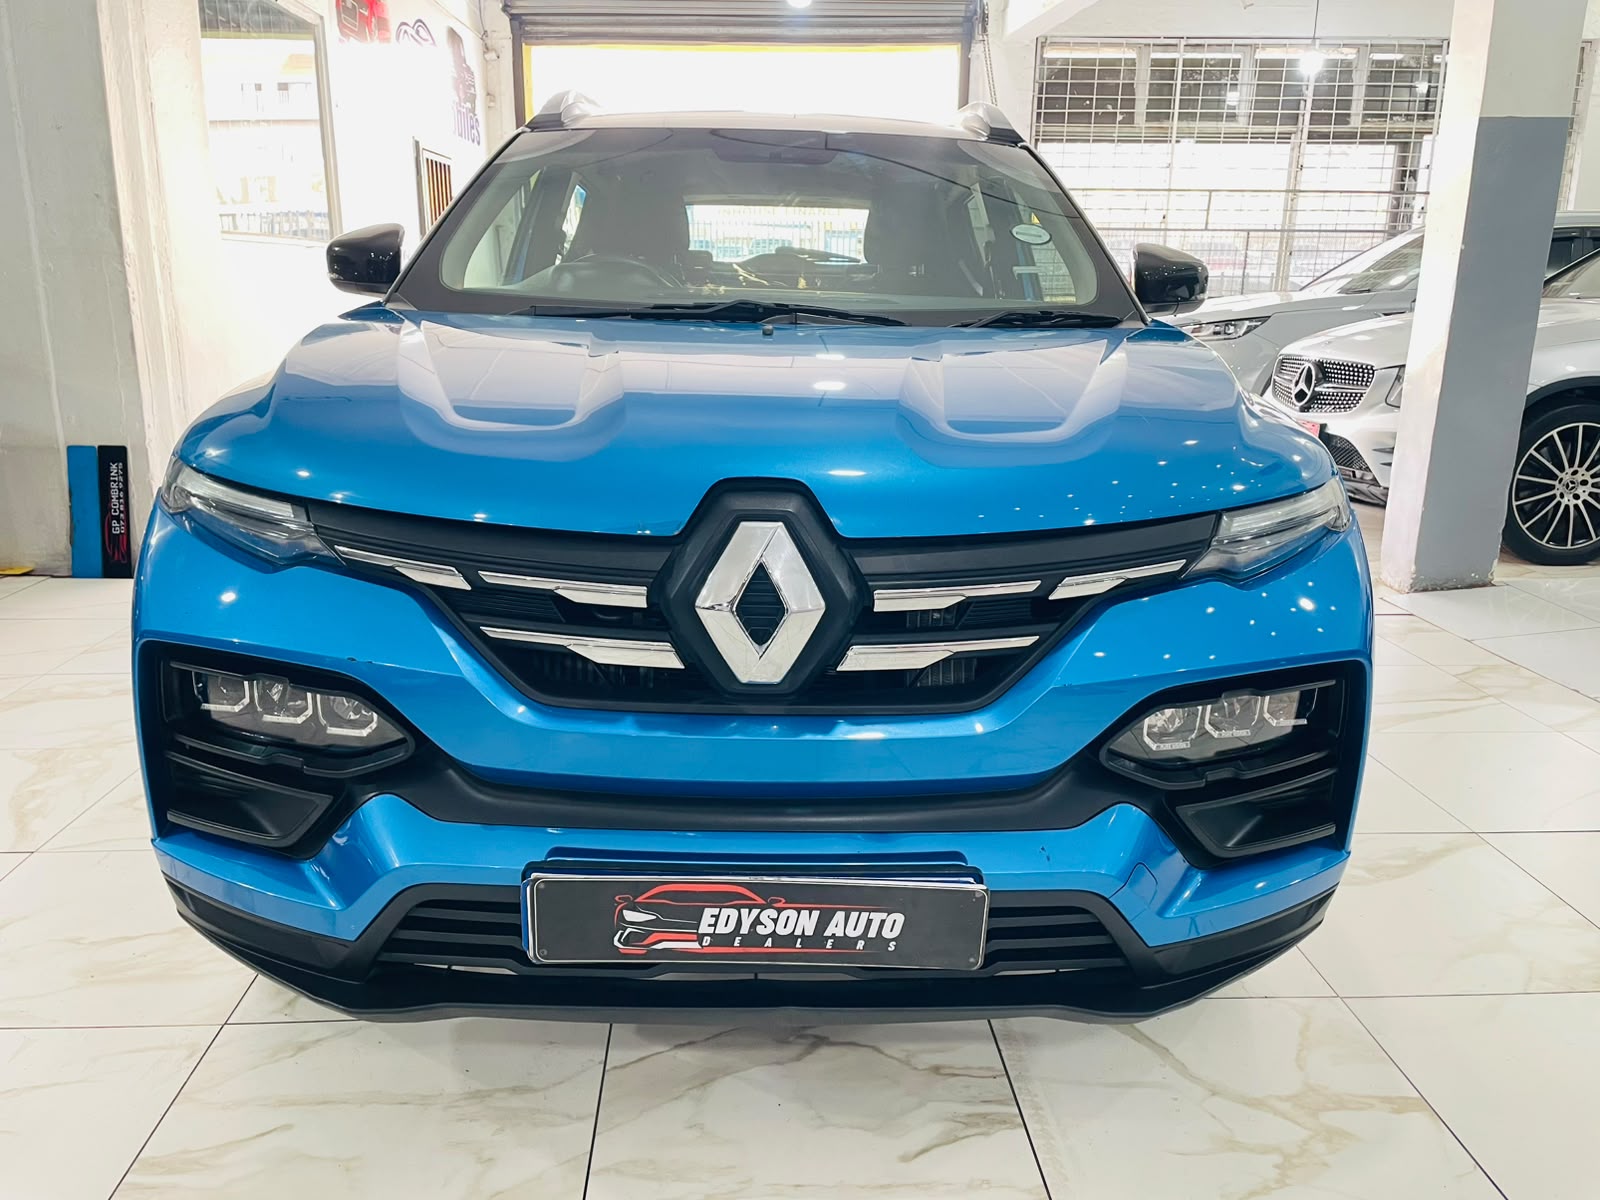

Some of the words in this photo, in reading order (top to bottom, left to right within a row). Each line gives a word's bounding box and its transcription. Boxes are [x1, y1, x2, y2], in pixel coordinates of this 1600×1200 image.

[110, 462, 120, 516] COMBRINK
[112, 520, 120, 534] GP
[698, 907, 821, 936] EDYSON
[823, 910, 906, 940] AUTO
[702, 936, 897, 951] DEALERS
